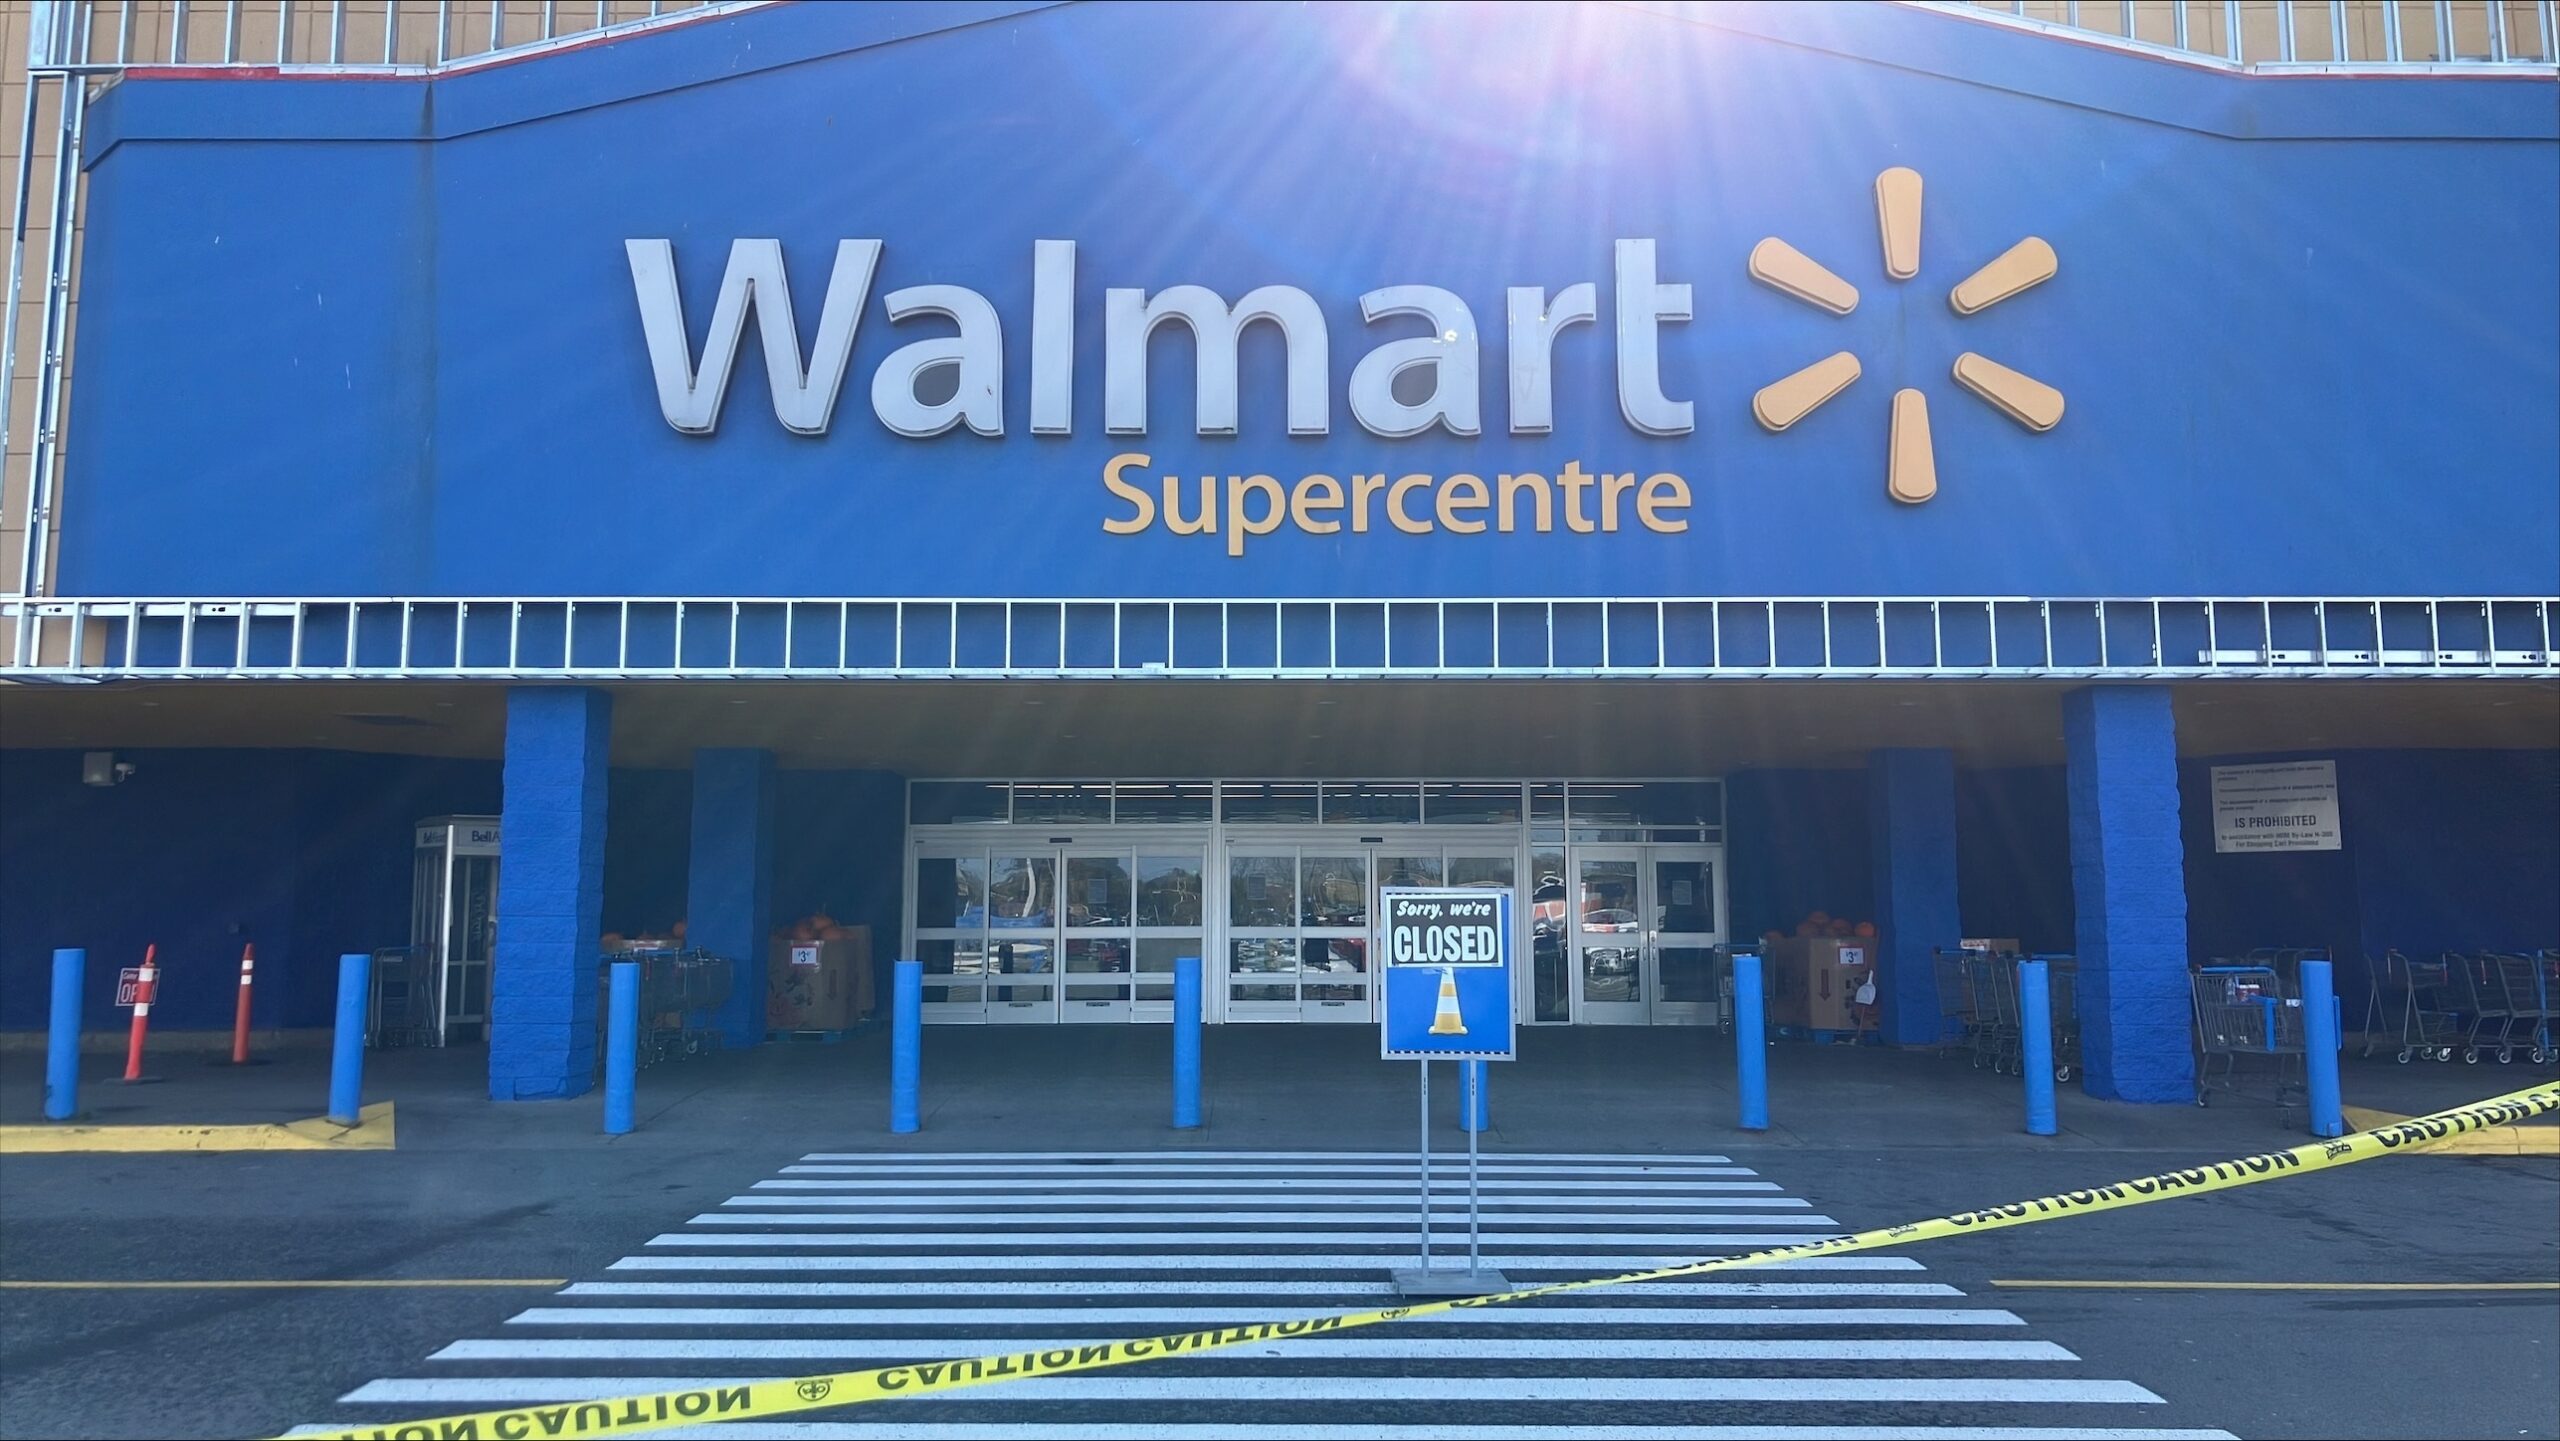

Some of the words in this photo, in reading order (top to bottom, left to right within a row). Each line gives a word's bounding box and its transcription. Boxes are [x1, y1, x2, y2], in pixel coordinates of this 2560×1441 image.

[625, 238, 1695, 437] Walmart
[1102, 453, 1691, 556] Supercentre
[2234, 817, 2246, 828] IS
[2249, 815, 2317, 828] PROHIBITED
[1449, 901, 1491, 916] we're
[1394, 925, 1496, 962] CLOSED
[2369, 1100, 2532, 1148] CAUTION
